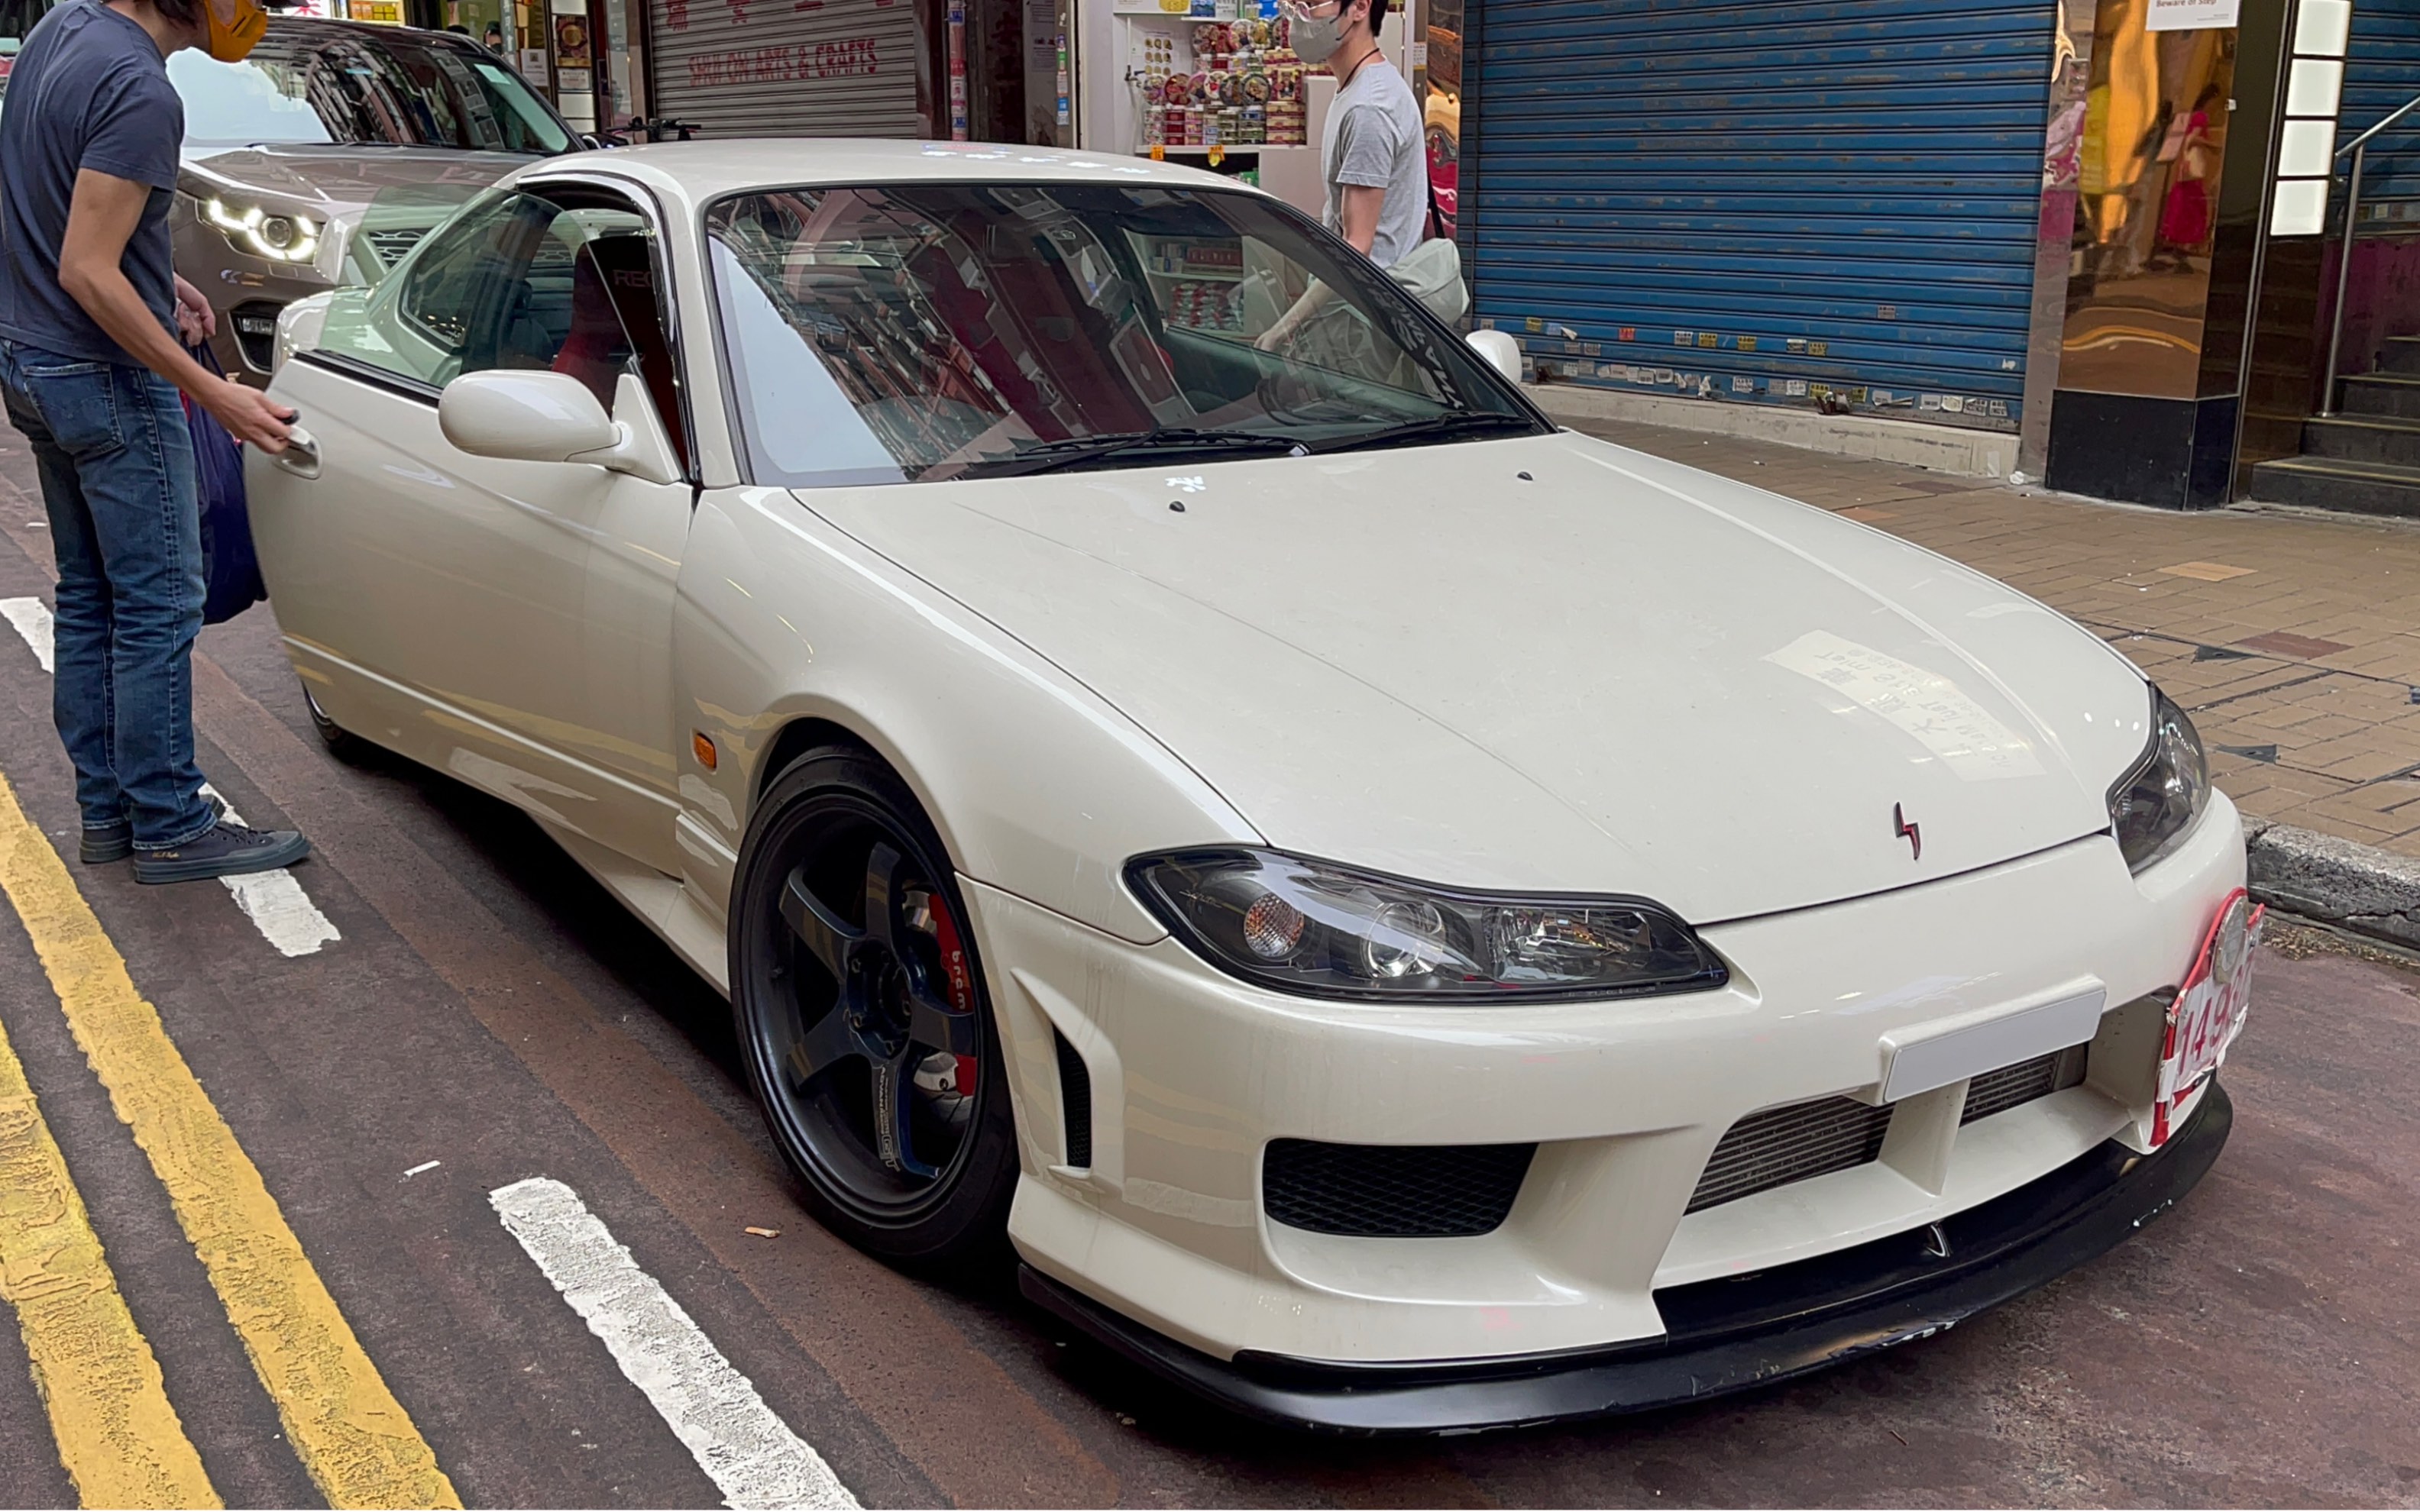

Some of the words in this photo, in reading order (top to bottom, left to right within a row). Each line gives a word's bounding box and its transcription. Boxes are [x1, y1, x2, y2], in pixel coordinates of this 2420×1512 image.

[755, 47, 791, 81] ARTS
[798, 46, 810, 79] &
[816, 37, 877, 78] CRAFTS
